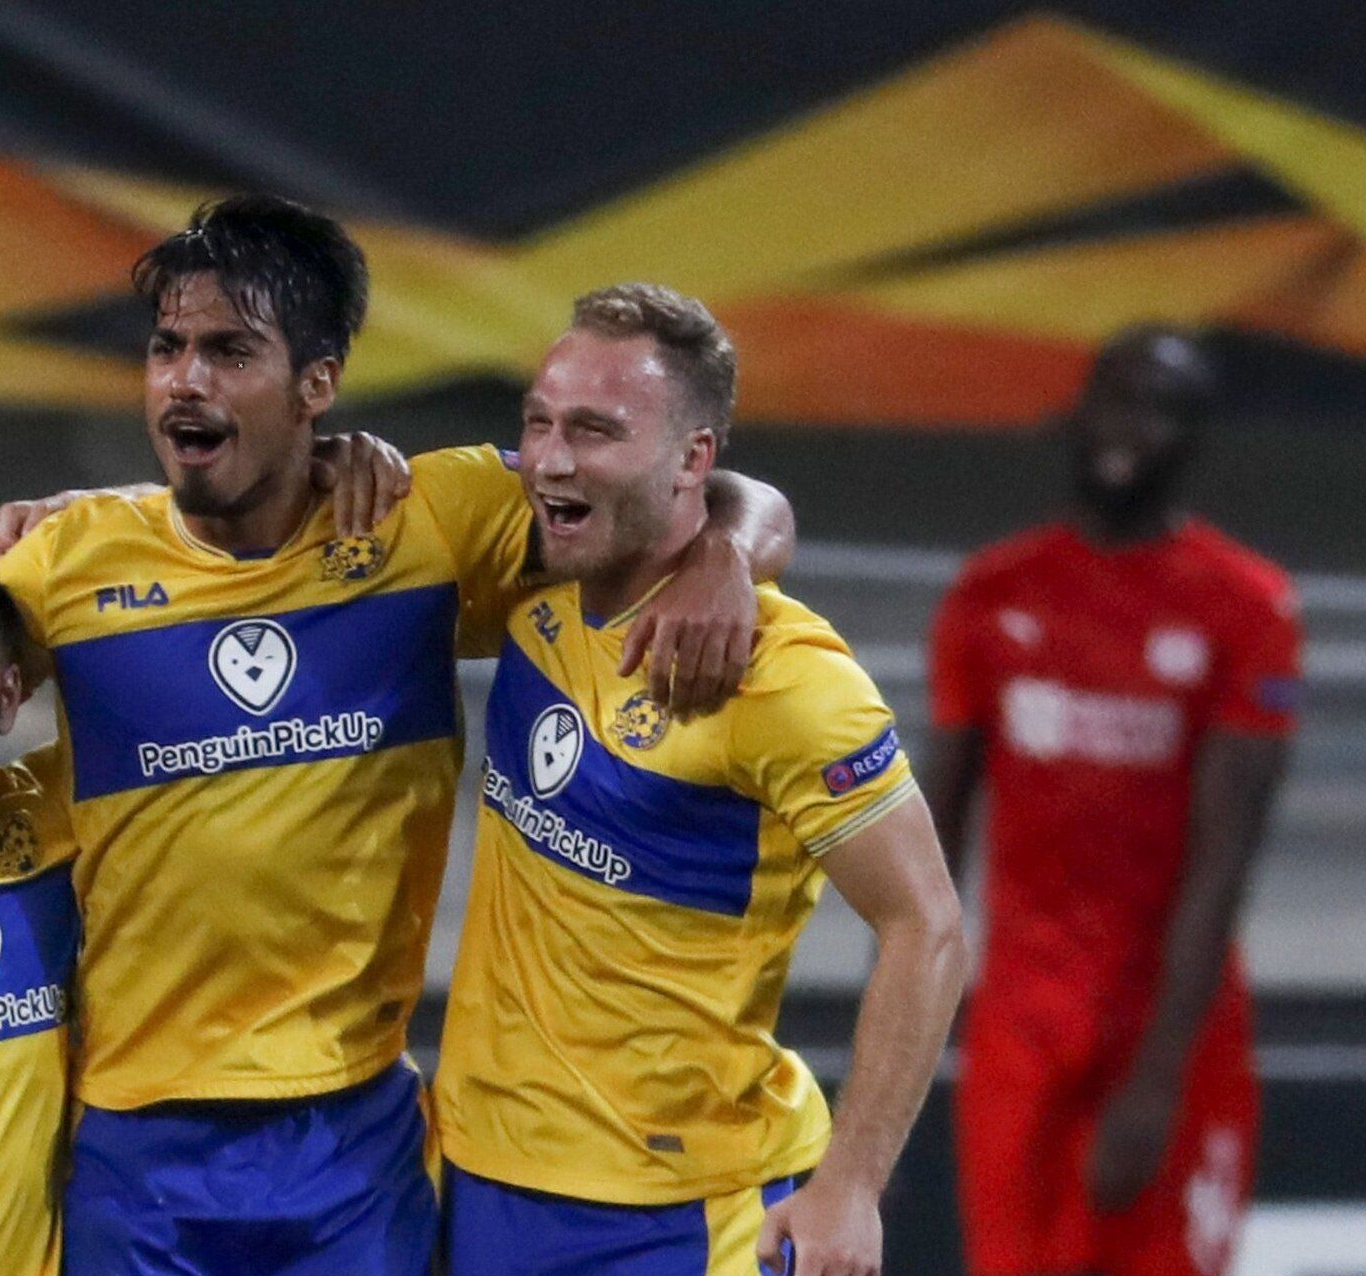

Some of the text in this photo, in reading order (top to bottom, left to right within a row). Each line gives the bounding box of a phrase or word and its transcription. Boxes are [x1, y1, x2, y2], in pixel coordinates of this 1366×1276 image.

[96, 581, 170, 612] FILA
[528, 601, 561, 644] FILA
[139, 711, 383, 777] PenguinPickUp
